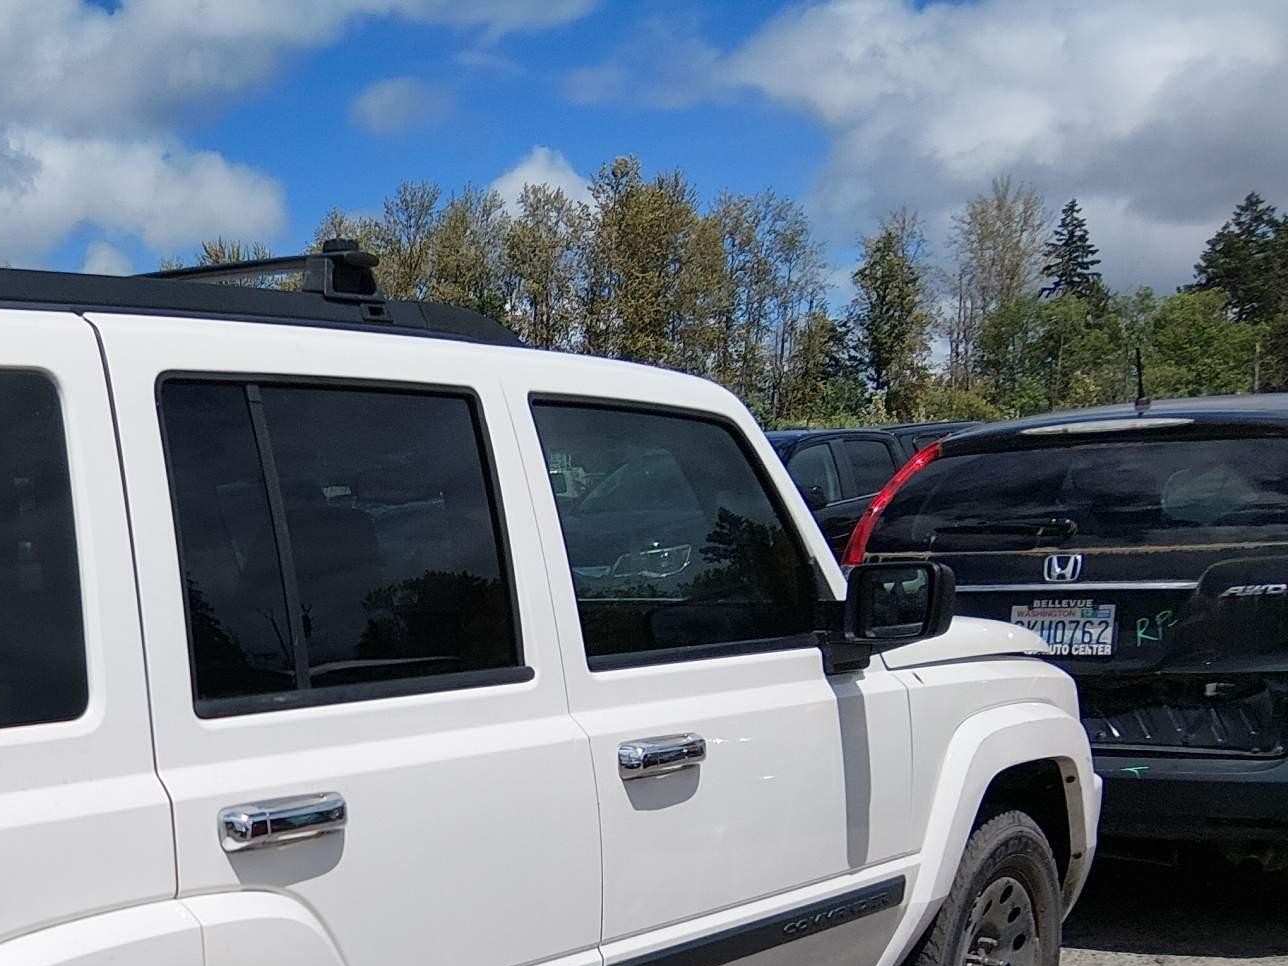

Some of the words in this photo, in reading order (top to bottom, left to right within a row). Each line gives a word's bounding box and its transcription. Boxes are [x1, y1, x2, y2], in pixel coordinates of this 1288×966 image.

[1219, 584, 1287, 597] AWD
[1032, 599, 1095, 608] BELLEVUE
[1016, 608, 1076, 617] WASHINGTON
[1014, 620, 1110, 644] U0762
[1047, 644, 1069, 655] UTO
[1071, 644, 1112, 655] CENTER
